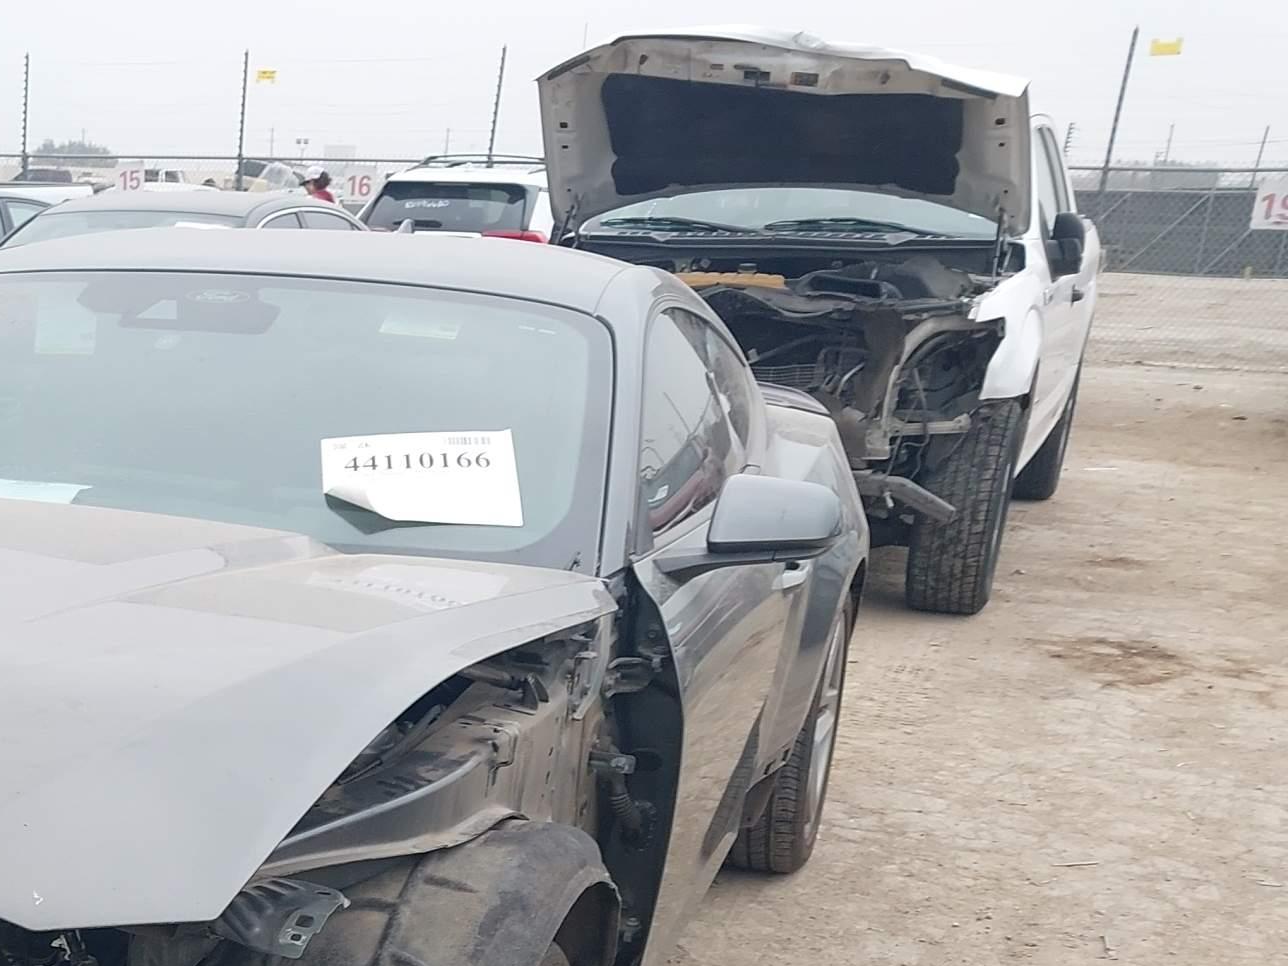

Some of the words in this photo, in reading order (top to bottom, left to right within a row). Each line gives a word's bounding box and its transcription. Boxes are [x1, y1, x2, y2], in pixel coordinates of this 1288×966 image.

[119, 169, 141, 191] 15
[347, 175, 371, 197] 16
[344, 451, 491, 472] 44110166
